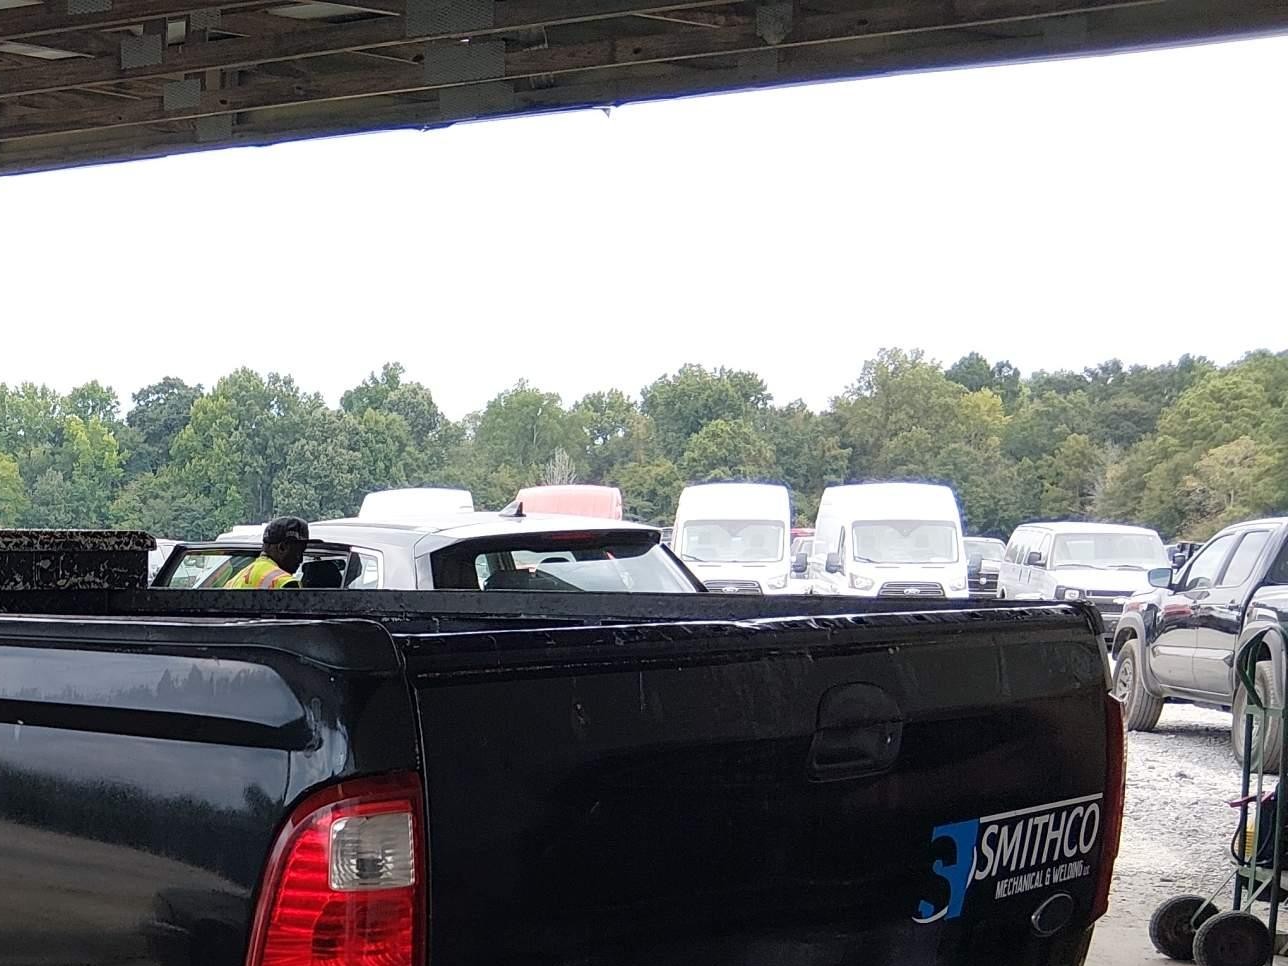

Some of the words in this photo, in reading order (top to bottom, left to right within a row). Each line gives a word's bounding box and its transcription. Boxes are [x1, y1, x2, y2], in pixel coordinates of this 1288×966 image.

[974, 803, 1100, 880] SMITHCO
[995, 871, 1043, 899] MECHANICAL
[1052, 860, 1084, 884] WELDING
